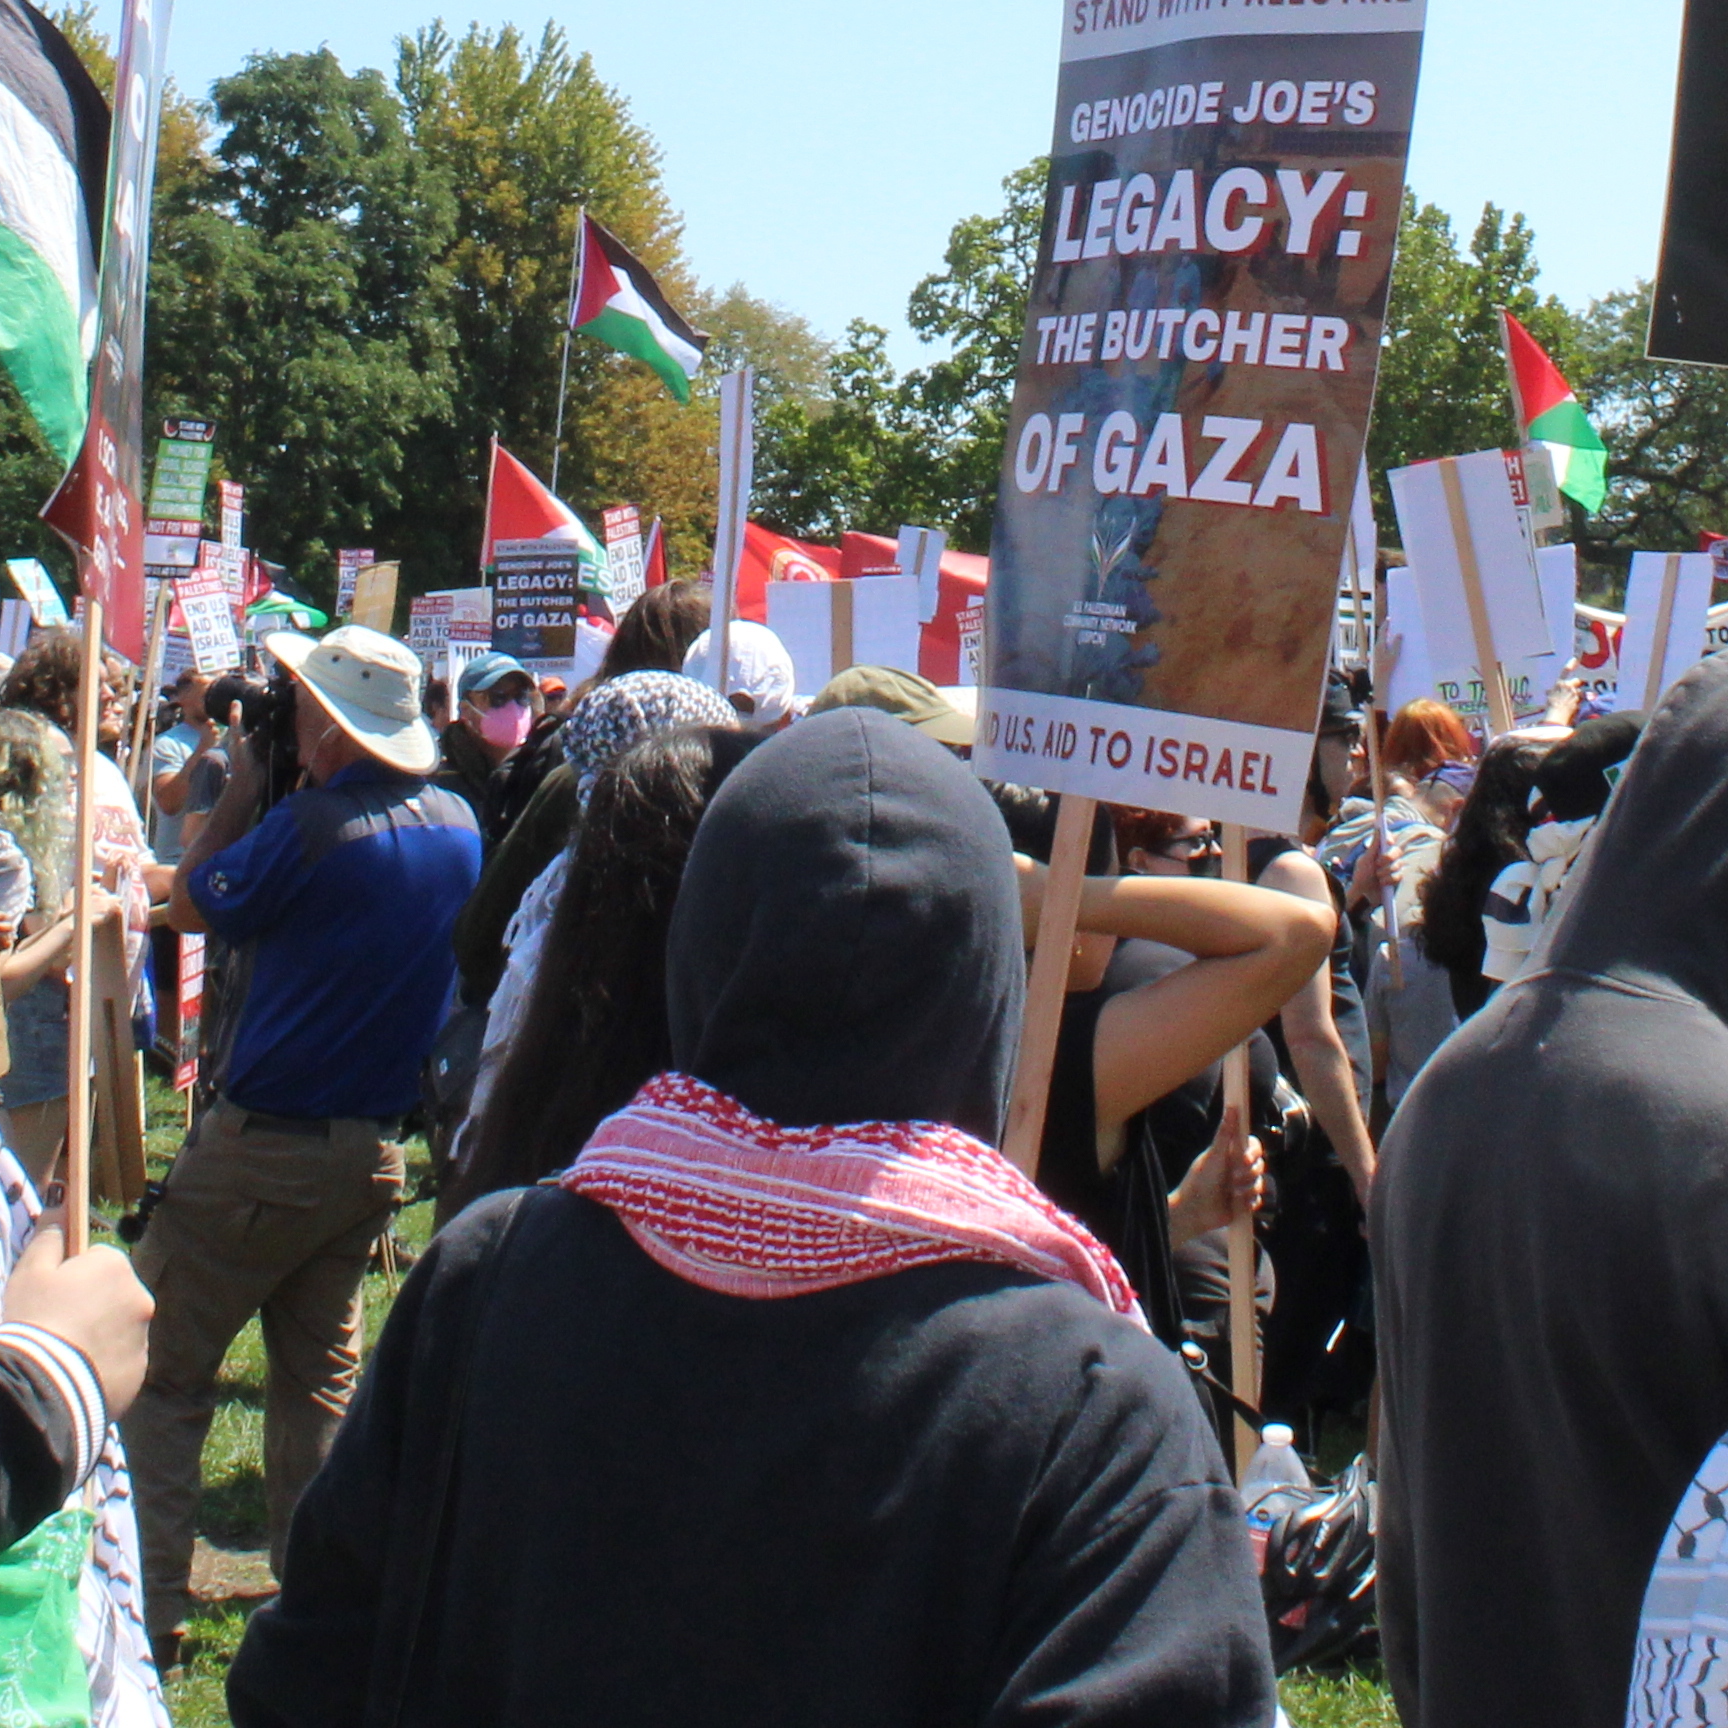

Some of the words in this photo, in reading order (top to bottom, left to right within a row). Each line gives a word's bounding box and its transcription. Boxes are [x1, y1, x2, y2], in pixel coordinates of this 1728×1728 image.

[1071, 81, 1224, 143] GENOCIDE
[1232, 80, 1376, 127] JOE'S
[1052, 167, 1369, 264] LEGACY:
[1036, 311, 1098, 366] THE
[1101, 308, 1350, 372] BUTCHER
[1014, 412, 1084, 494] OF
[1092, 410, 1324, 514] GAZA
[149, 520, 165, 534] NOT
[166, 521, 181, 534] FOR
[611, 547, 625, 565] END
[498, 561, 542, 570] GENOCIDE
[613, 567, 627, 584] AID
[628, 561, 642, 578] TO
[497, 574, 574, 590] LEGACY:
[186, 602, 208, 616] END
[212, 597, 226, 612] U.S
[435, 597, 452, 605] WITH
[497, 597, 518, 607] THE
[520, 596, 574, 606] BUTCHER
[192, 617, 213, 633] AID
[216, 614, 230, 629] TO
[413, 617, 431, 627] END
[496, 614, 519, 630] OF
[522, 612, 573, 627] GAZA
[955, 608, 980, 622] STAND
[413, 628, 432, 638] AID
[436, 627, 450, 637] TO
[1099, 617, 1137, 634] NETWORK
[196, 633, 234, 652] ISRAEL!
[1438, 681, 1460, 700] TO
[1004, 719, 1036, 755] U.S.
[1042, 723, 1077, 761] AID
[1090, 727, 1133, 768] TO
[1144, 735, 1279, 796] ISRAEL
